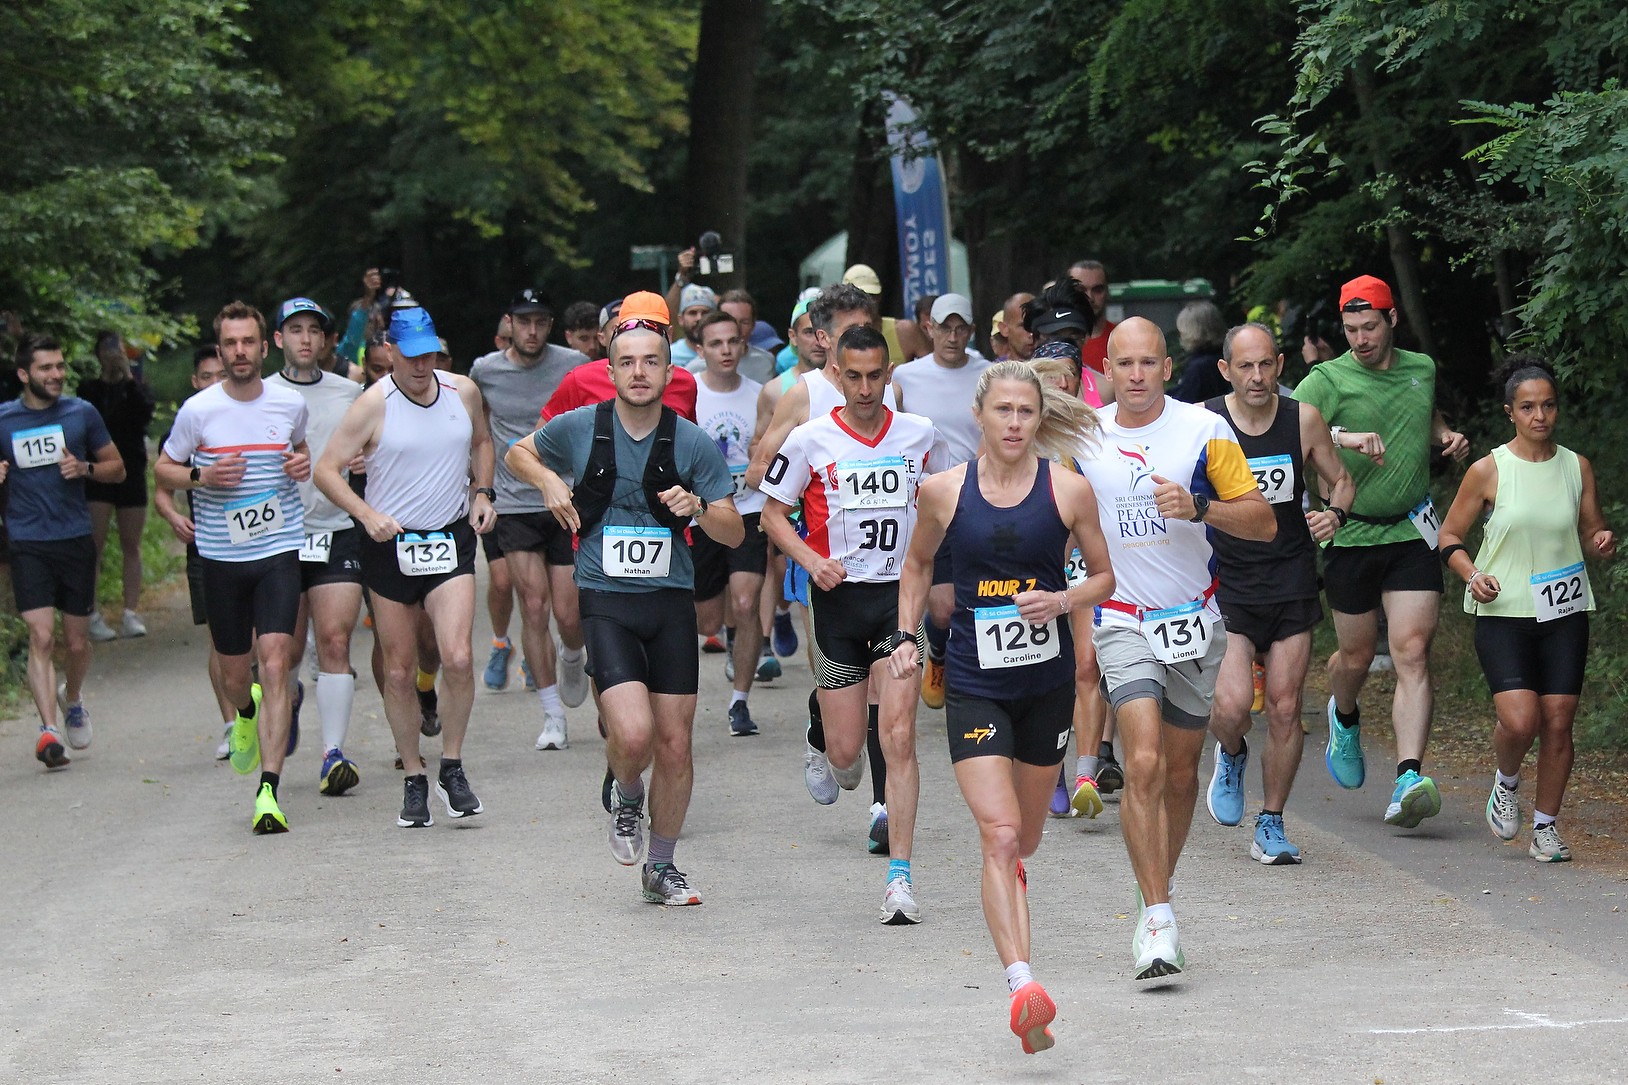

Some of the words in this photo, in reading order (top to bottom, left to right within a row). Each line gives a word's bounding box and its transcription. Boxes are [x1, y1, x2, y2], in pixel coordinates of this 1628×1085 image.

[22, 436, 56, 457] 115
[845, 469, 900, 496] 140
[1252, 468, 1286, 493] 39
[1115, 501, 1154, 509] ONENESS-HO
[1127, 494, 1156, 502] CHINM
[232, 502, 276, 531] 126
[1423, 506, 1440, 531] 11
[858, 518, 899, 552] 30
[1118, 518, 1167, 538] RUN
[304, 533, 330, 551] 14
[612, 539, 664, 564] 107
[404, 542, 451, 564] 132
[411, 565, 447, 573] Christophe
[623, 567, 651, 575] Nathan
[1067, 559, 1087, 580] 29
[977, 579, 1021, 597] HOUR
[1025, 578, 1037, 593] 7
[1540, 576, 1583, 607] 122
[985, 621, 1050, 652] 128
[1153, 615, 1206, 649] 131
[1003, 653, 1042, 664] Caroline
[1172, 648, 1198, 660] Lionel
